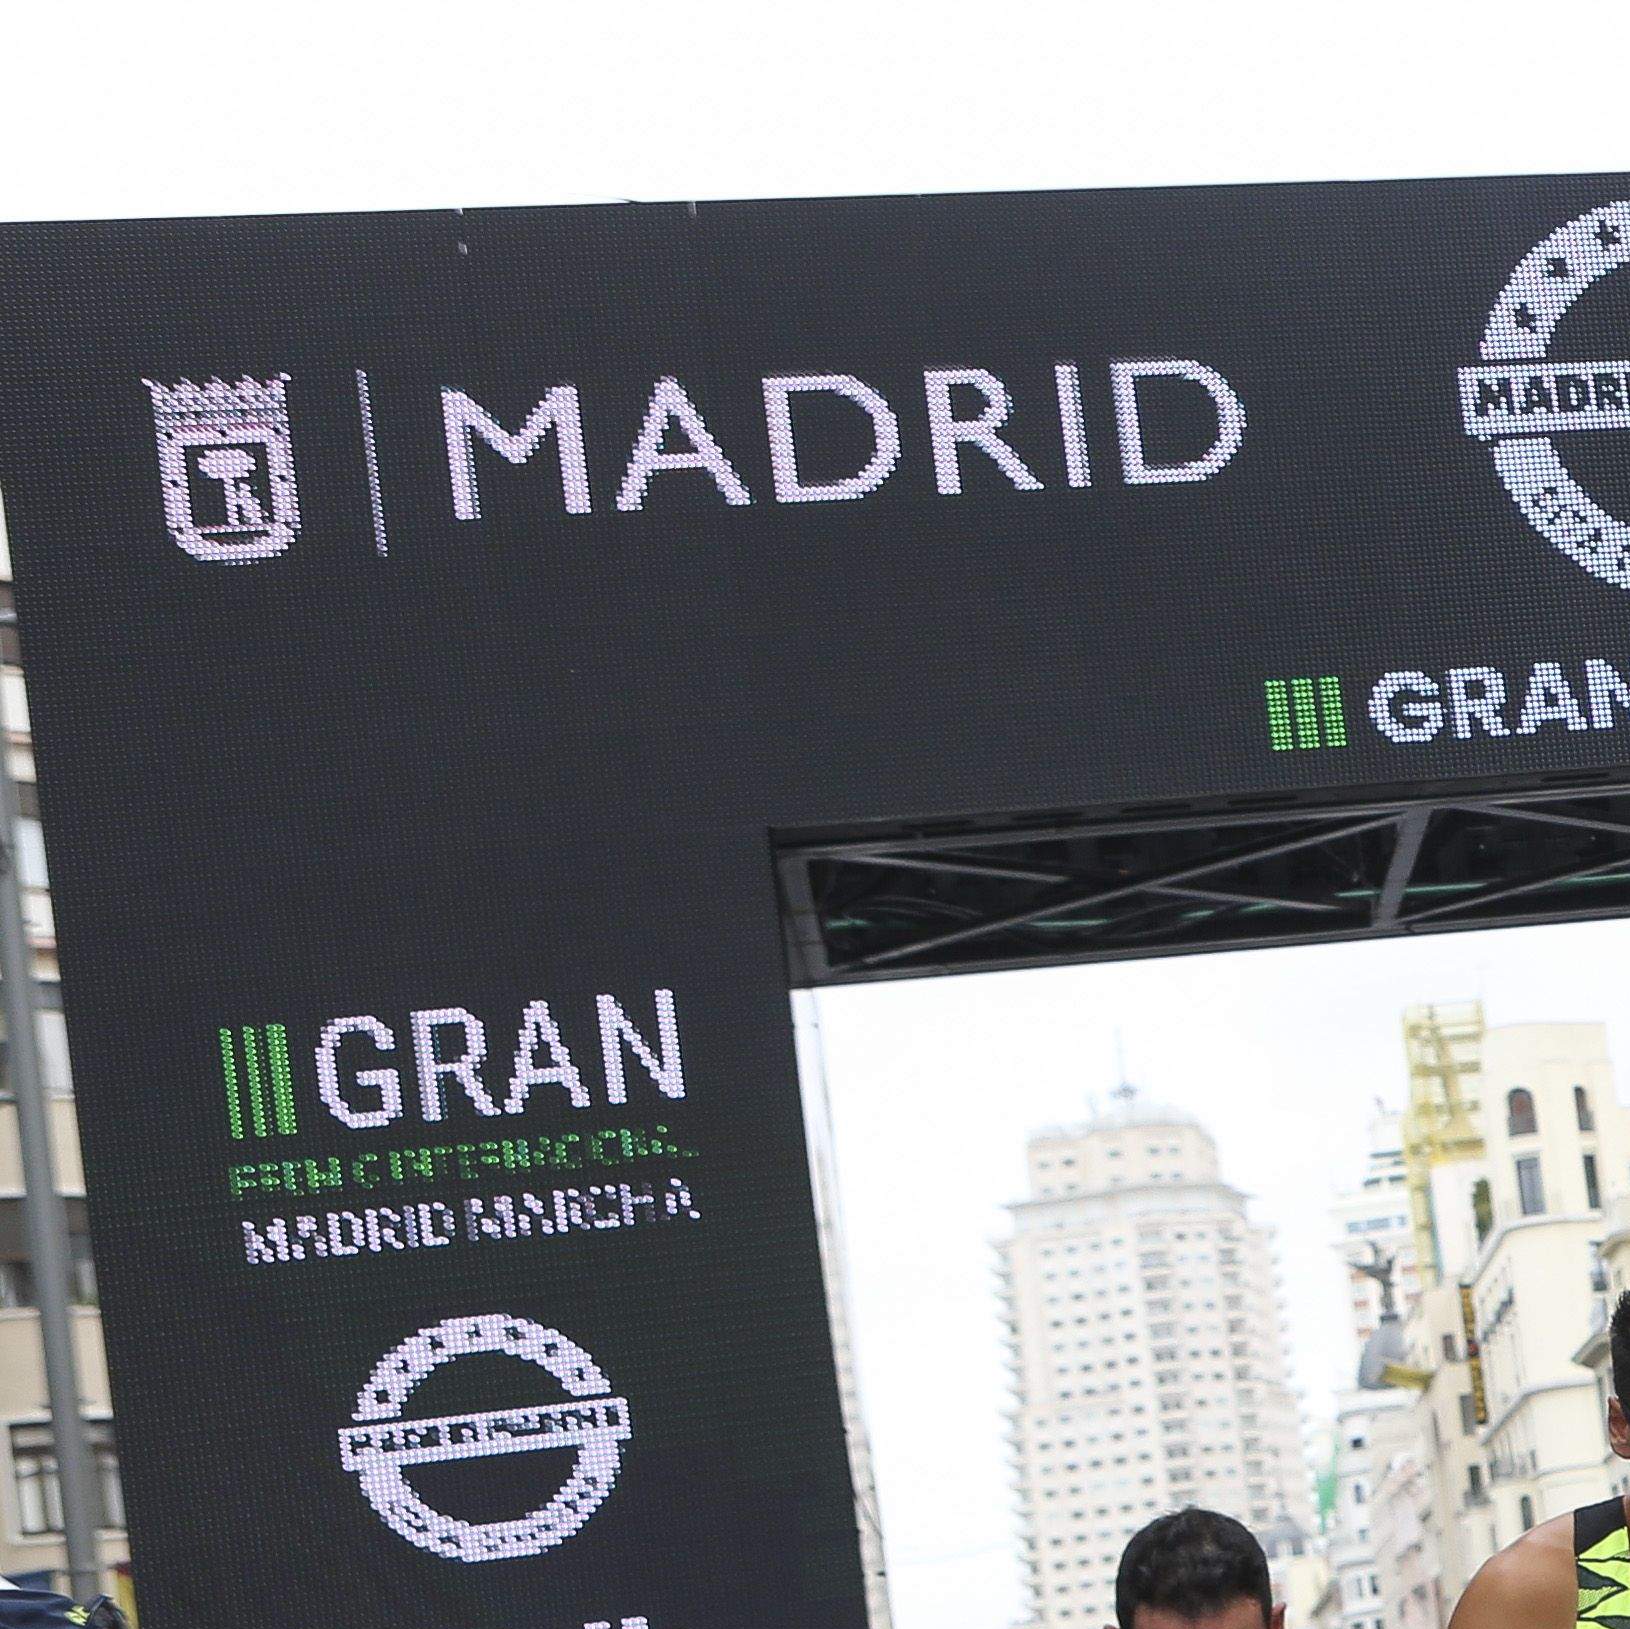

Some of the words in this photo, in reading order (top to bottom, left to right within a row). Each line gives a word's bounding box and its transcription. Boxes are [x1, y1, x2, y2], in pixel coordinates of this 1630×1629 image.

[441, 357, 1248, 521] MADRID
[315, 988, 686, 1130] GRAN
[242, 1200, 456, 1266] MADRID
[466, 1176, 702, 1242] MARCHA
